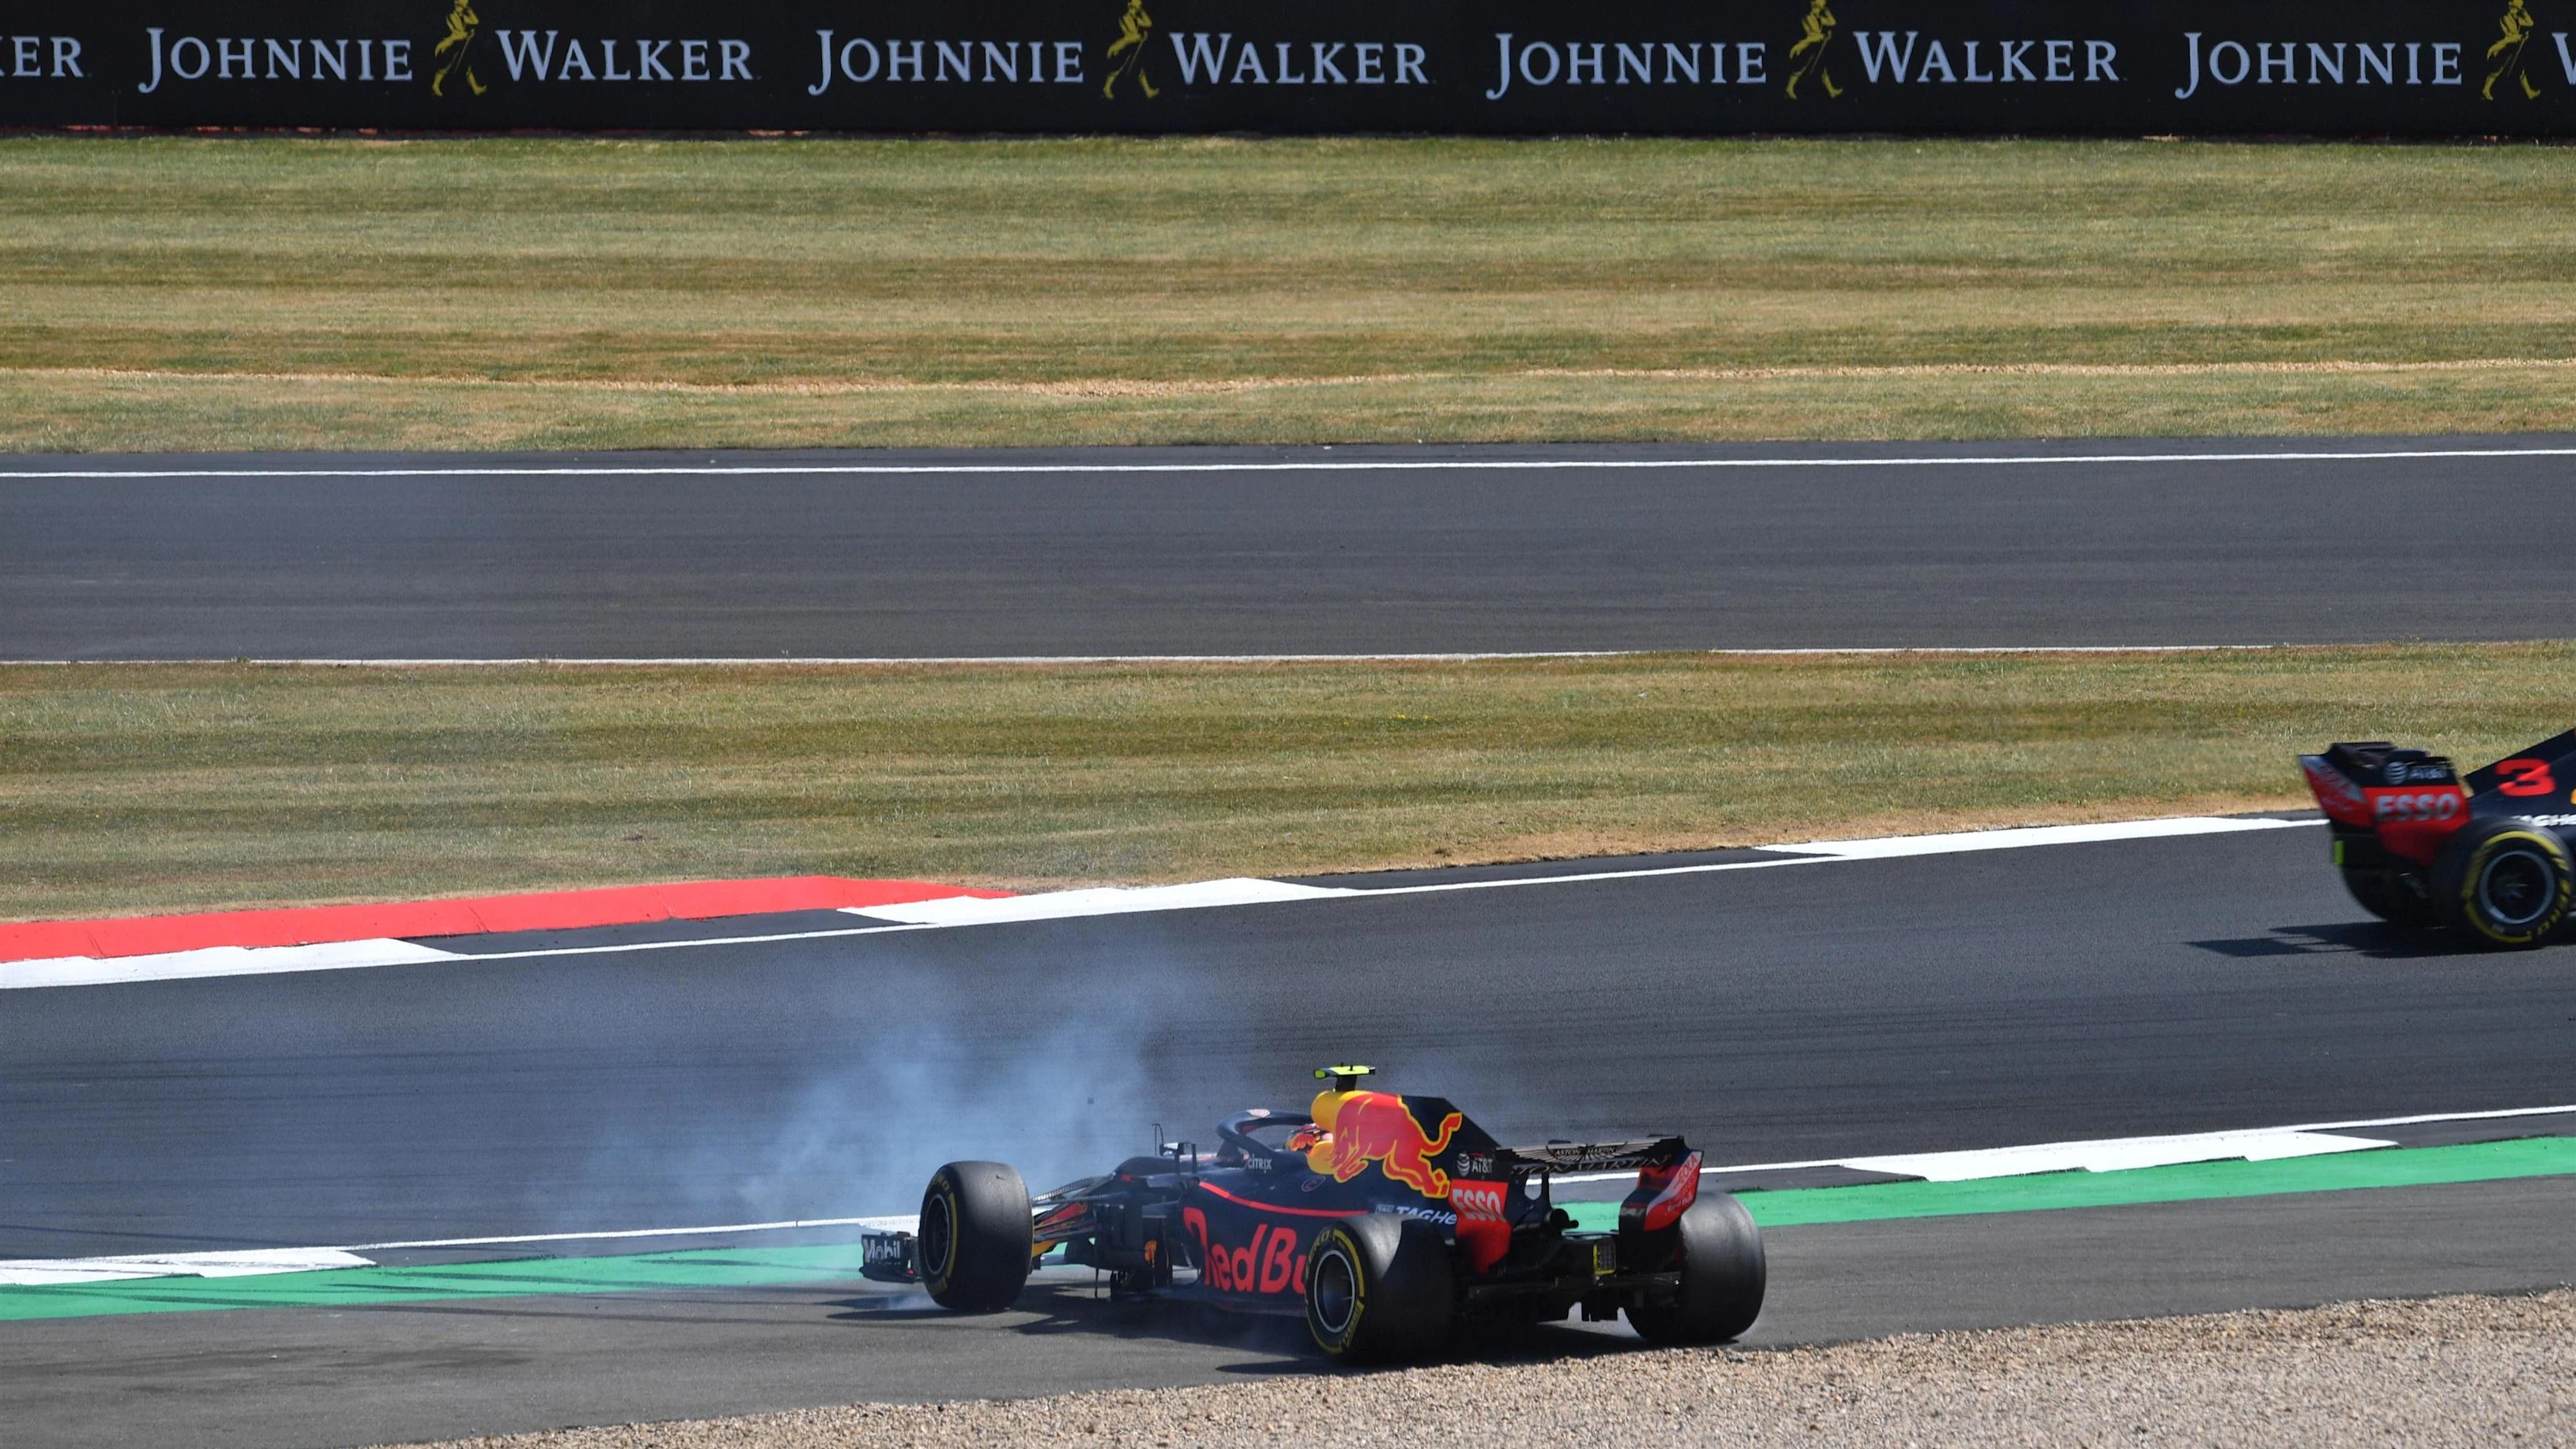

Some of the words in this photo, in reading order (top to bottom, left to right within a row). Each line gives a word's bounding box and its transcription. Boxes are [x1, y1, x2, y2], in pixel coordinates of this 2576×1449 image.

[0, 35, 85, 77] ER
[138, 27, 412, 93] JOHNNIE
[496, 30, 753, 81] WALKER
[807, 30, 1084, 97] JOHNNIE
[1170, 32, 1430, 85] WALKER
[1485, 32, 1767, 101] JOHNNIE
[1853, 31, 2120, 84] WALKER
[2174, 32, 2462, 100] JOHNNIE
[2496, 758, 2557, 797] 3
[2374, 791, 2462, 822] ESSO
[1472, 1157, 1494, 1174] AT&T
[1396, 1206, 1458, 1225] TAGHe
[1451, 1187, 1508, 1224] ESSO
[862, 1238, 901, 1264] Mobil
[1259, 1227, 1307, 1294] Bu
